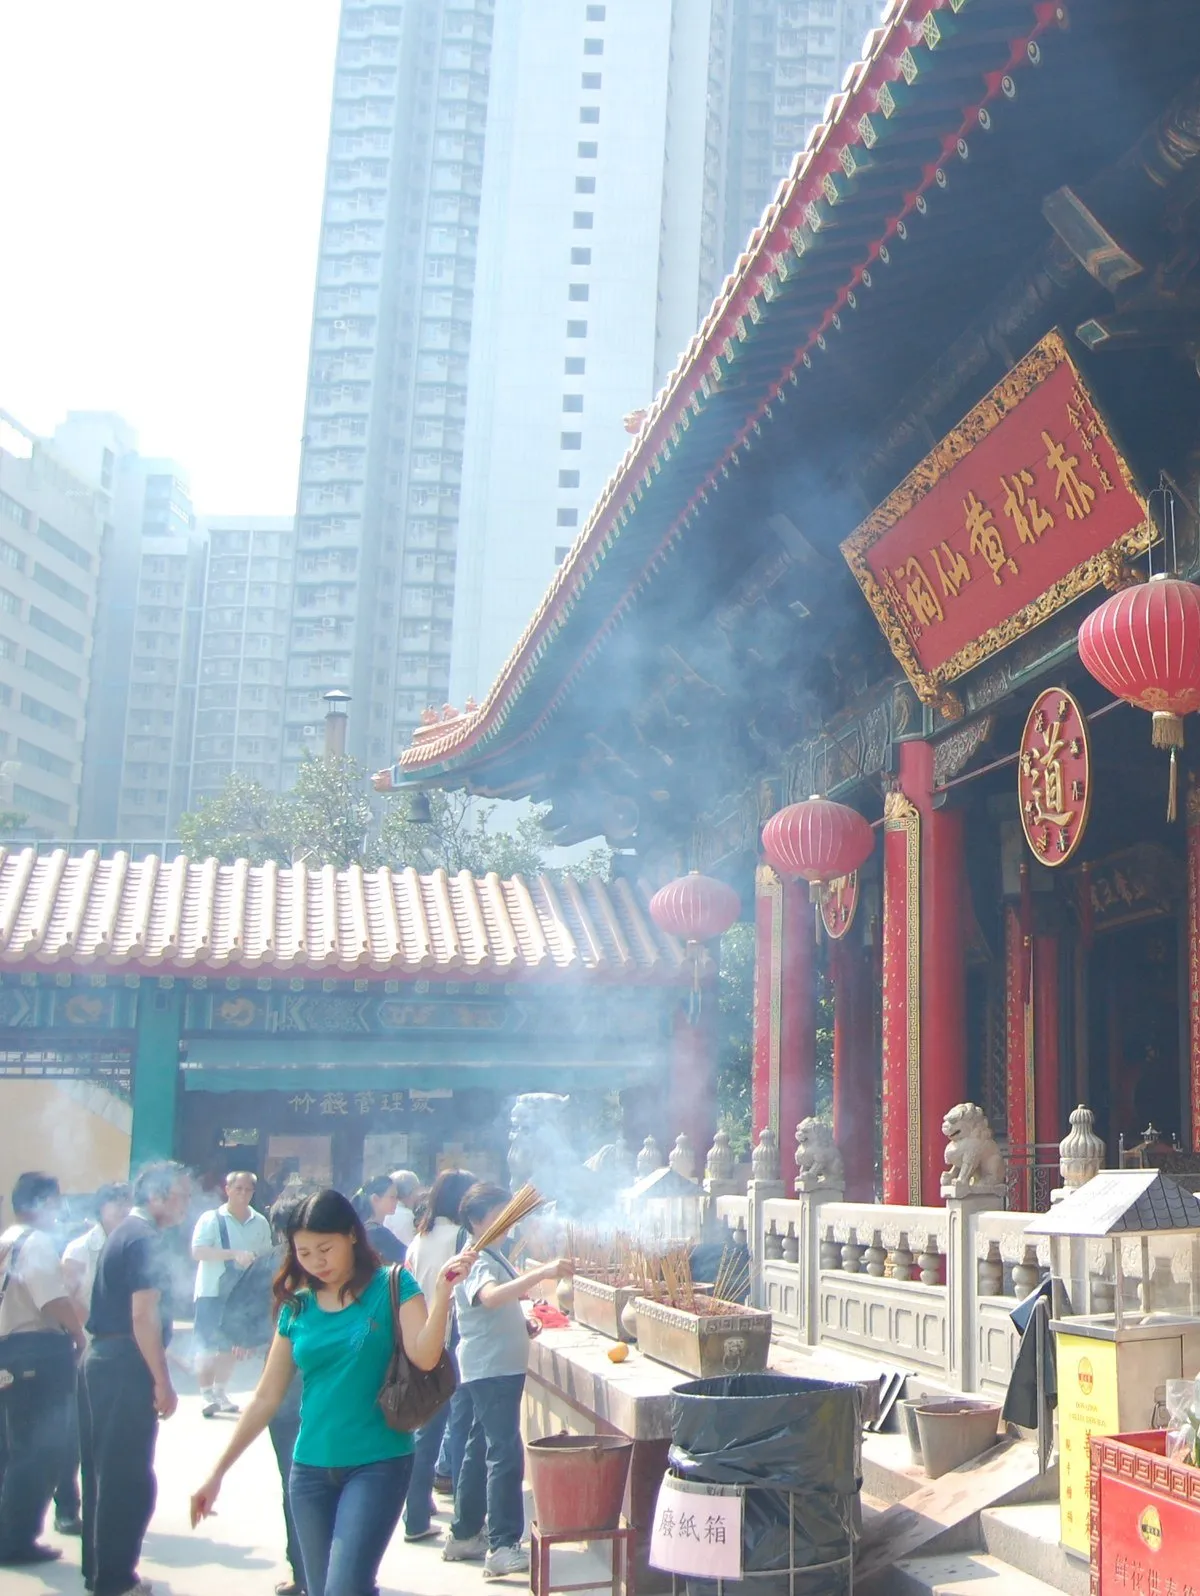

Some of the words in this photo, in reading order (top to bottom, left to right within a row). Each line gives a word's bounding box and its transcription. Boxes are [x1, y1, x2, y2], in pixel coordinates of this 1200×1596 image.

[1031, 721, 1074, 826] 道
[658, 1507, 728, 1545] 廢紙箱
